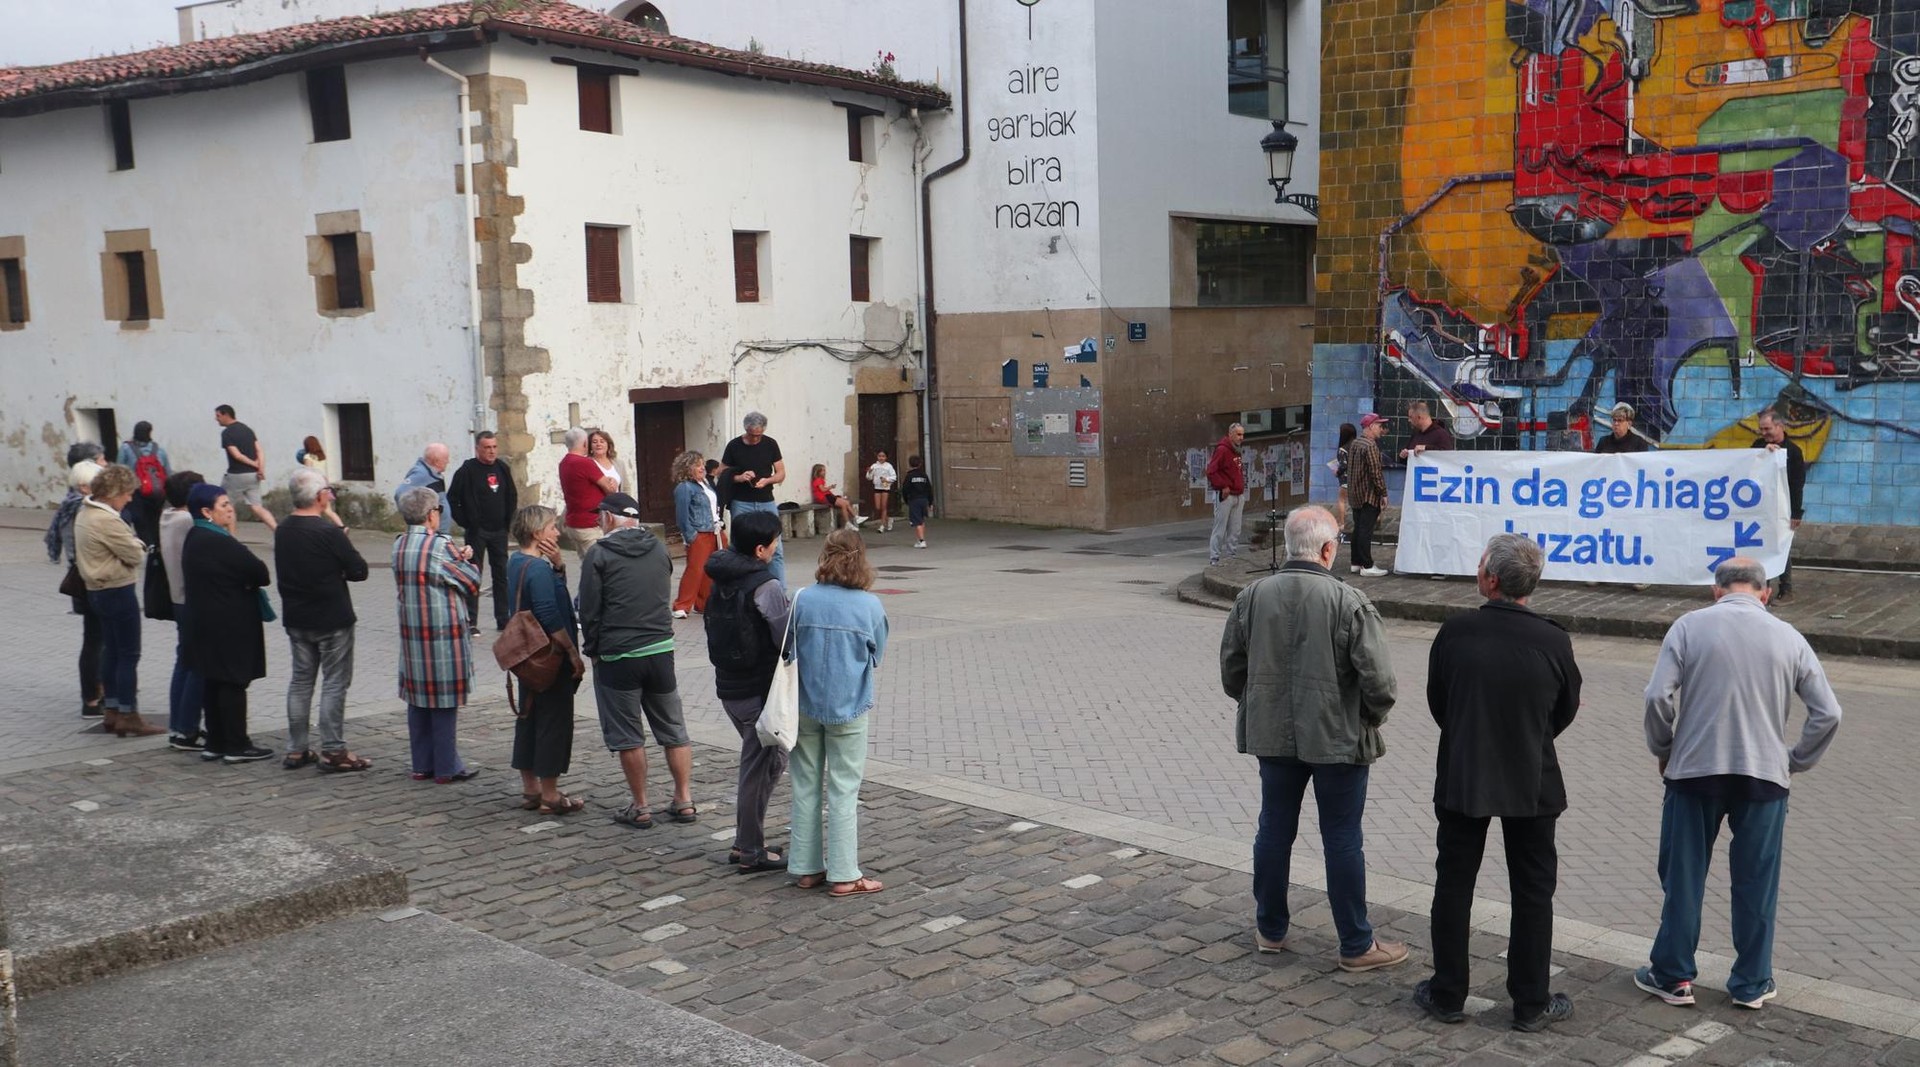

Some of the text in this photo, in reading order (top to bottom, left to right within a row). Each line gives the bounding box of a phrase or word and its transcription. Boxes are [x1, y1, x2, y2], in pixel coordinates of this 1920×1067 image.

[1008, 62, 1059, 94] aire
[987, 108, 1077, 142] garbiak
[1007, 155, 1062, 186] bira
[995, 200, 1080, 229] nazan
[1413, 465, 1763, 521] Ezin da gehiago
[1504, 519, 1656, 567] zatu.
